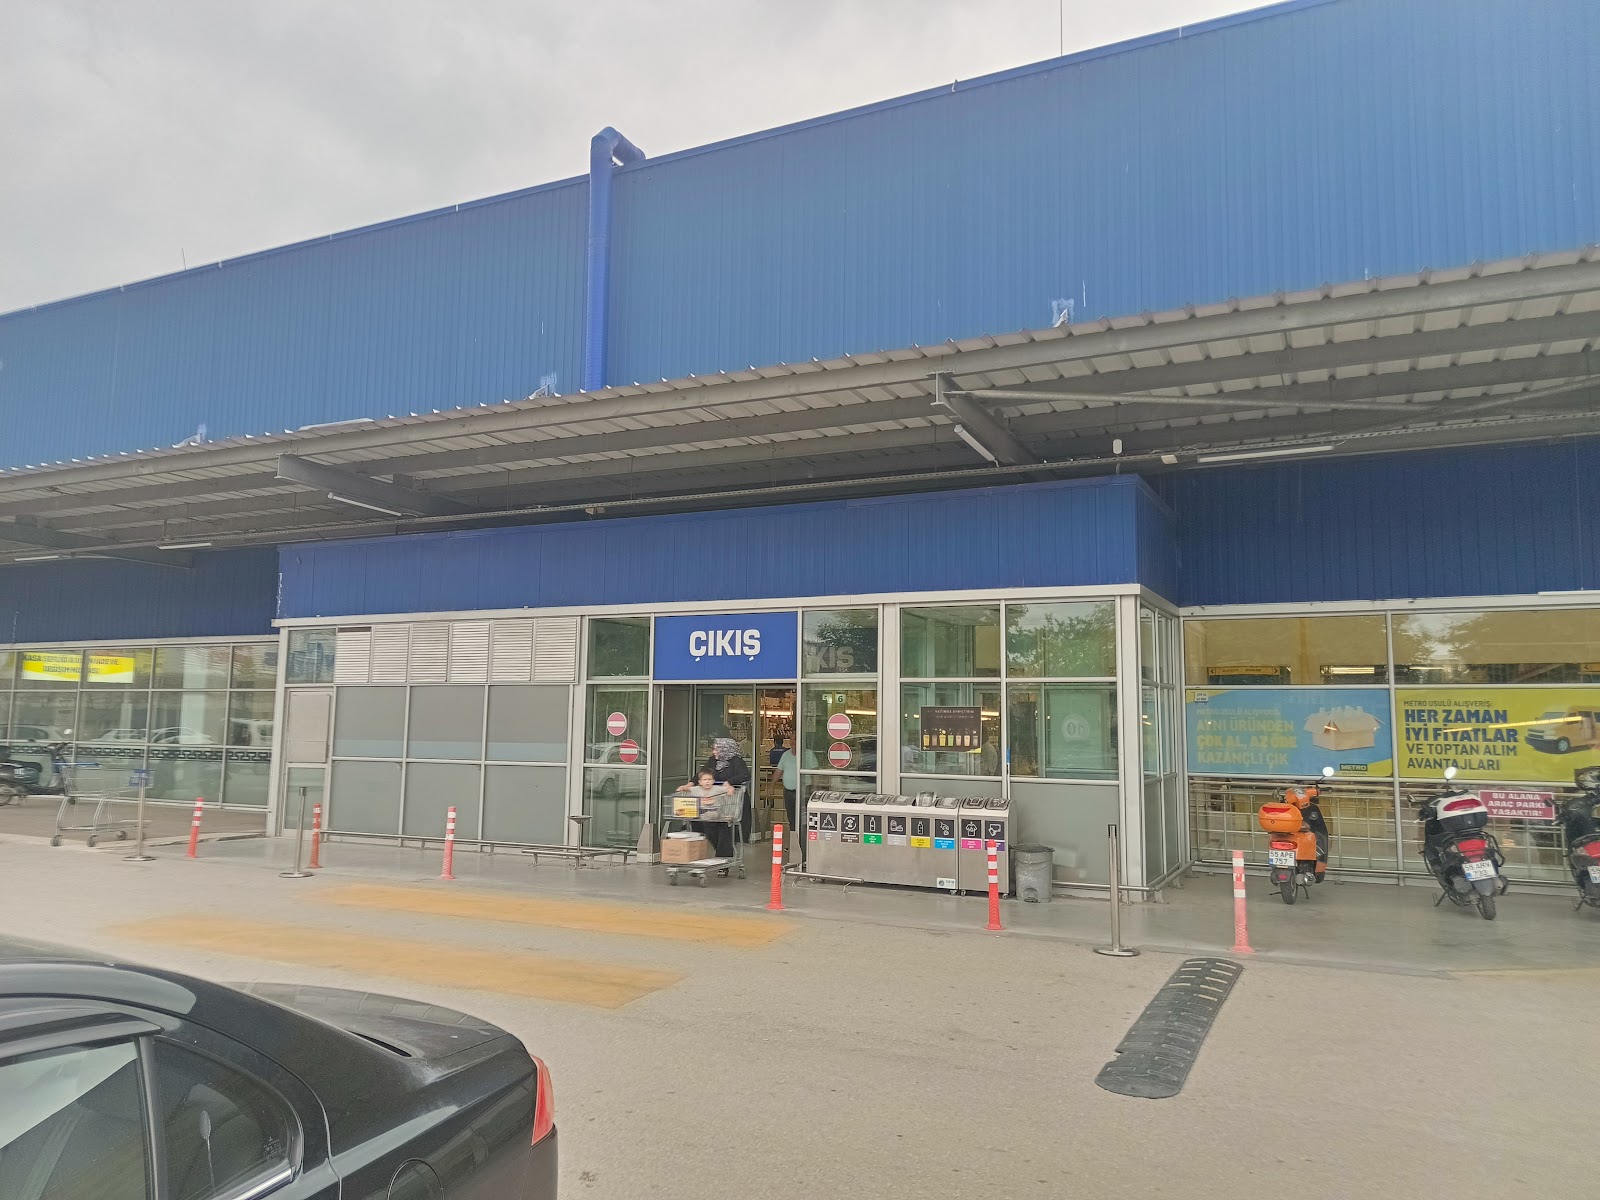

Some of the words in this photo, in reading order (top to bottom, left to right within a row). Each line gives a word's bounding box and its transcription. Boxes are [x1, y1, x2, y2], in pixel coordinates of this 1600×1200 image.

[690, 629, 760, 662] ÇIKIŞ
[1428, 699, 1452, 707] USULÜ
[1404, 709, 1438, 722] HER
[1442, 709, 1507, 723] ZAMAN
[1230, 717, 1294, 732] ÜRÜNDEN
[1405, 723, 1429, 741] İYİ
[1433, 723, 1518, 742] FİYATLAR
[1406, 743, 1423, 754] VE
[1427, 743, 1479, 755] TOPTAN
[1483, 745, 1517, 756] ALIM
[1407, 758, 1500, 771] AVANTAJLARI
[1491, 808, 1542, 816] YASAKTIR!
